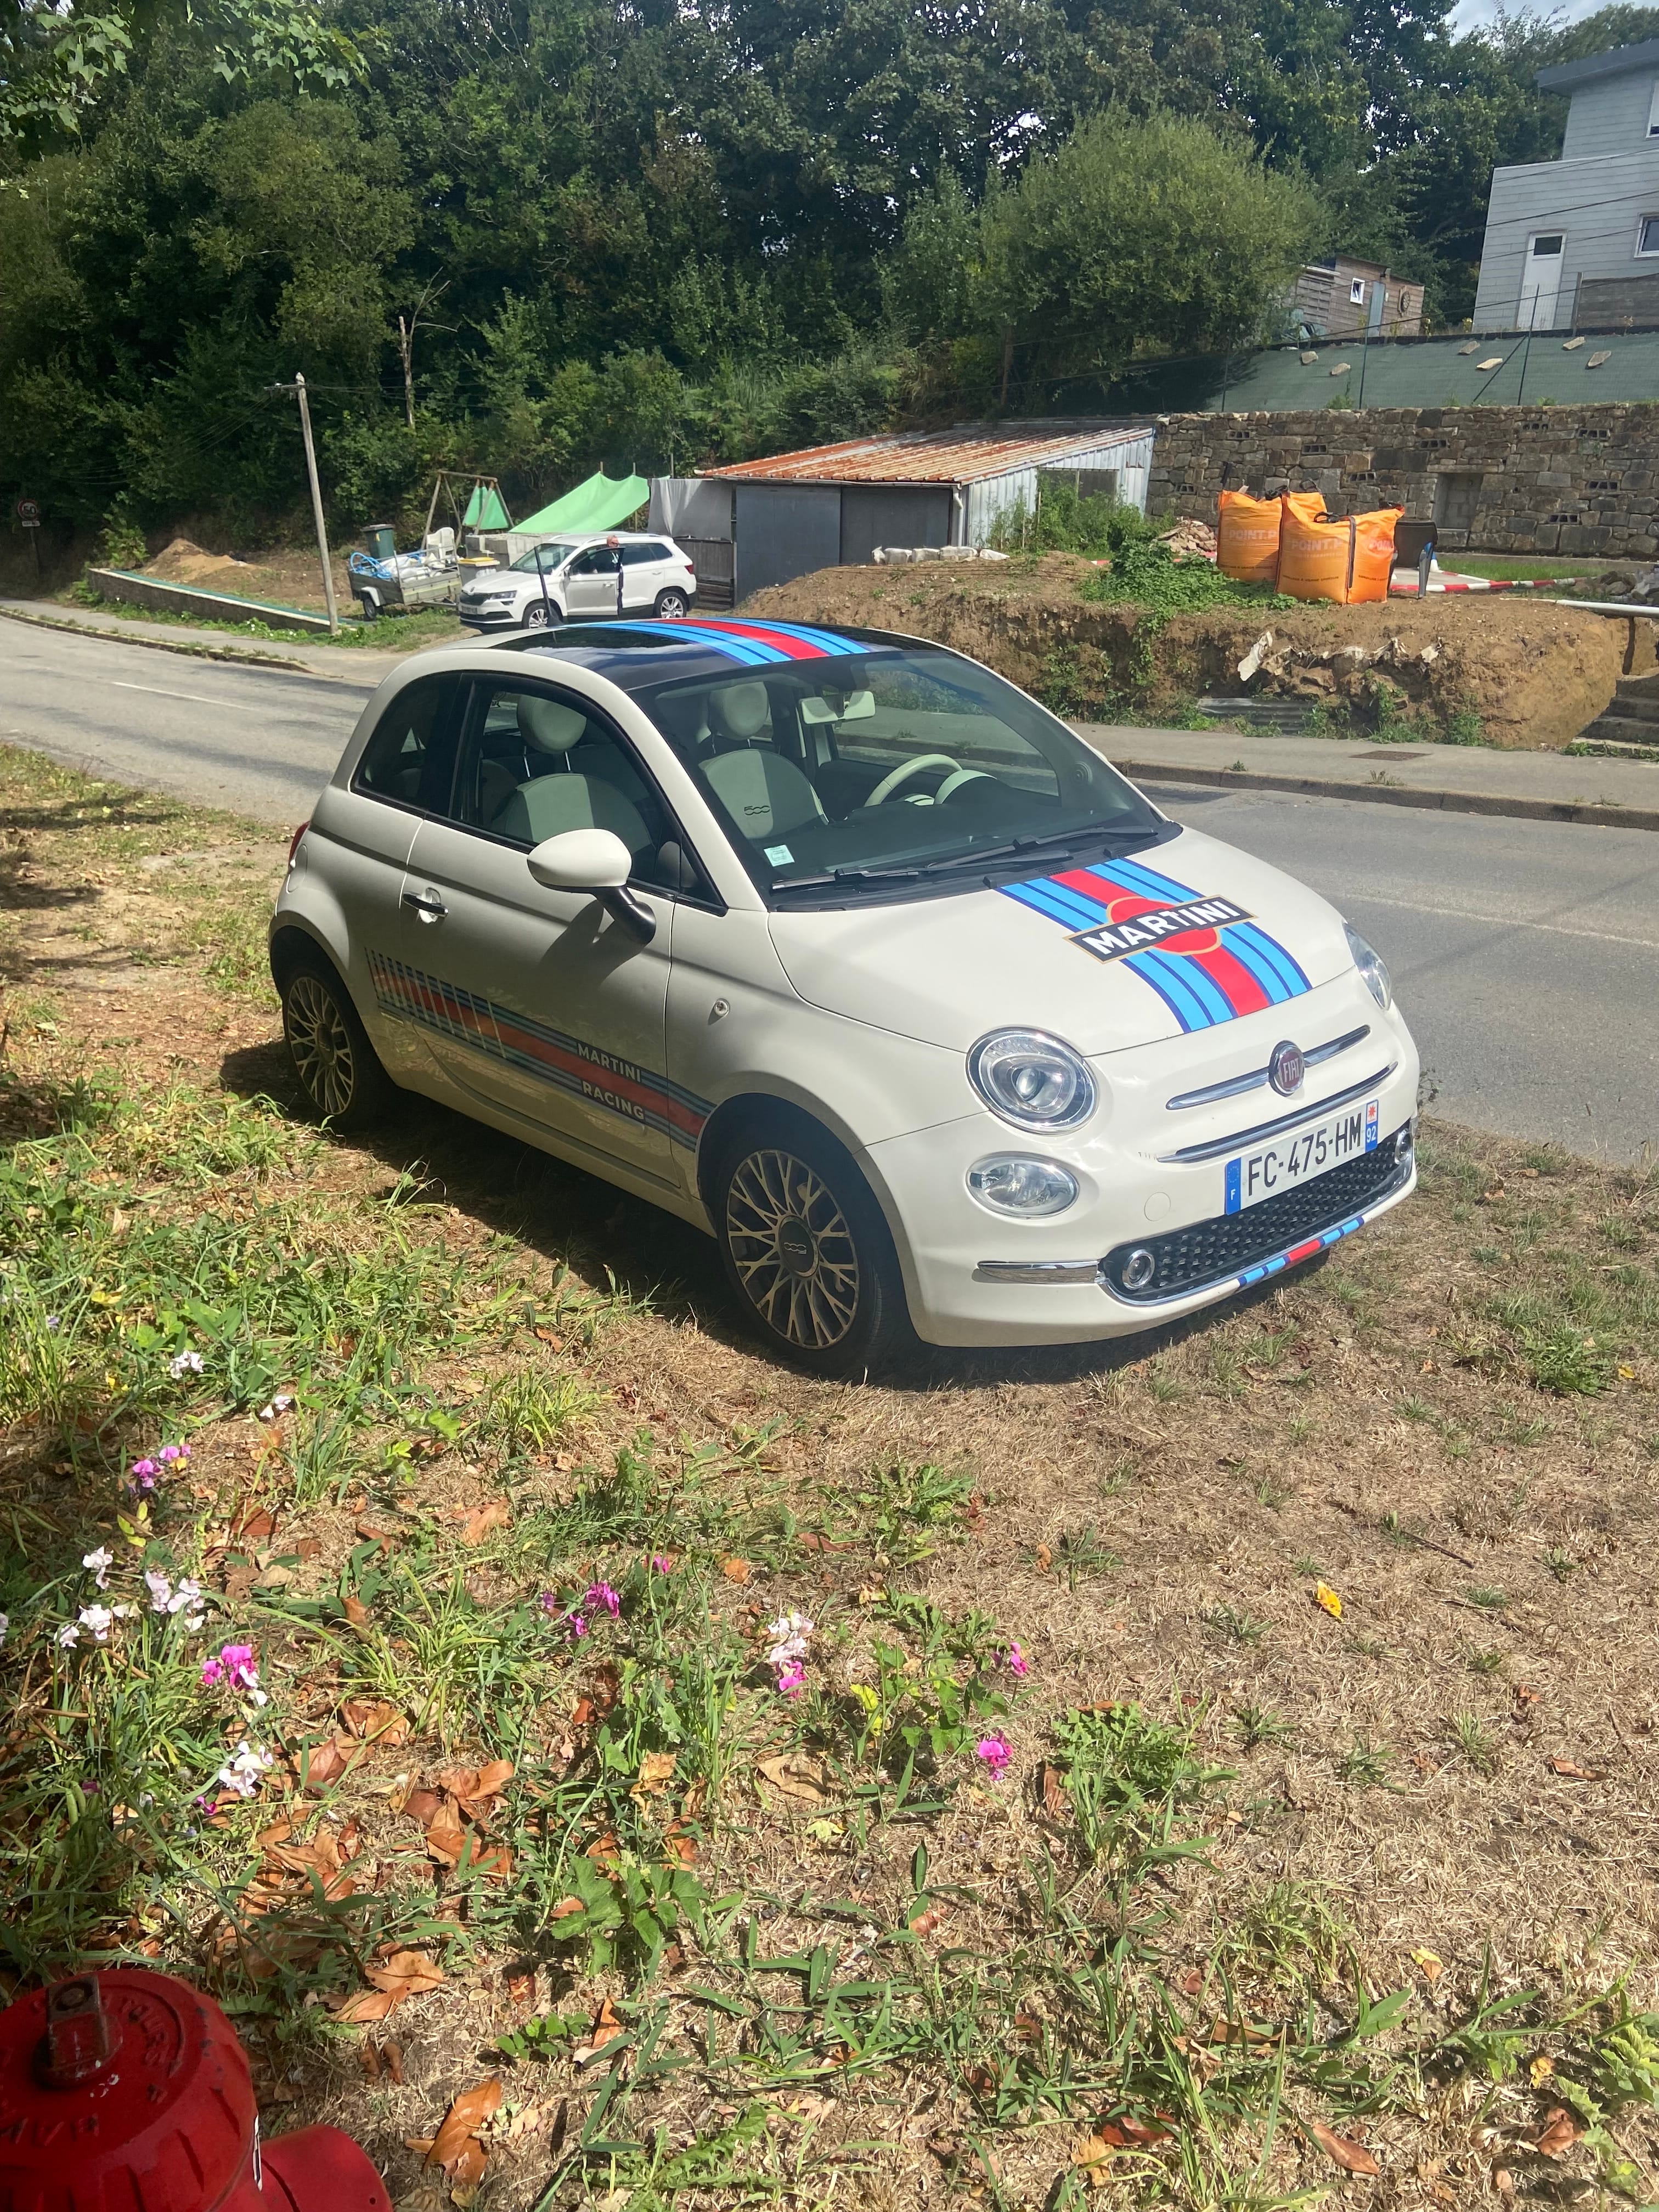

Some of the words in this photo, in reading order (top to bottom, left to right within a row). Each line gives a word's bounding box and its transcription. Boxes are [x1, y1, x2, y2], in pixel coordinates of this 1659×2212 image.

[744, 805, 771, 816] 500
[1082, 901, 1241, 955] MARTINI
[577, 1043, 641, 1082] MARTINI
[1283, 1057, 1299, 1083] FIAT
[582, 1081, 645, 1120] RACING
[1366, 1126, 1376, 1144] 92
[1248, 1113, 1362, 1197] FC-475-HM
[1230, 1188, 1236, 1201] F
